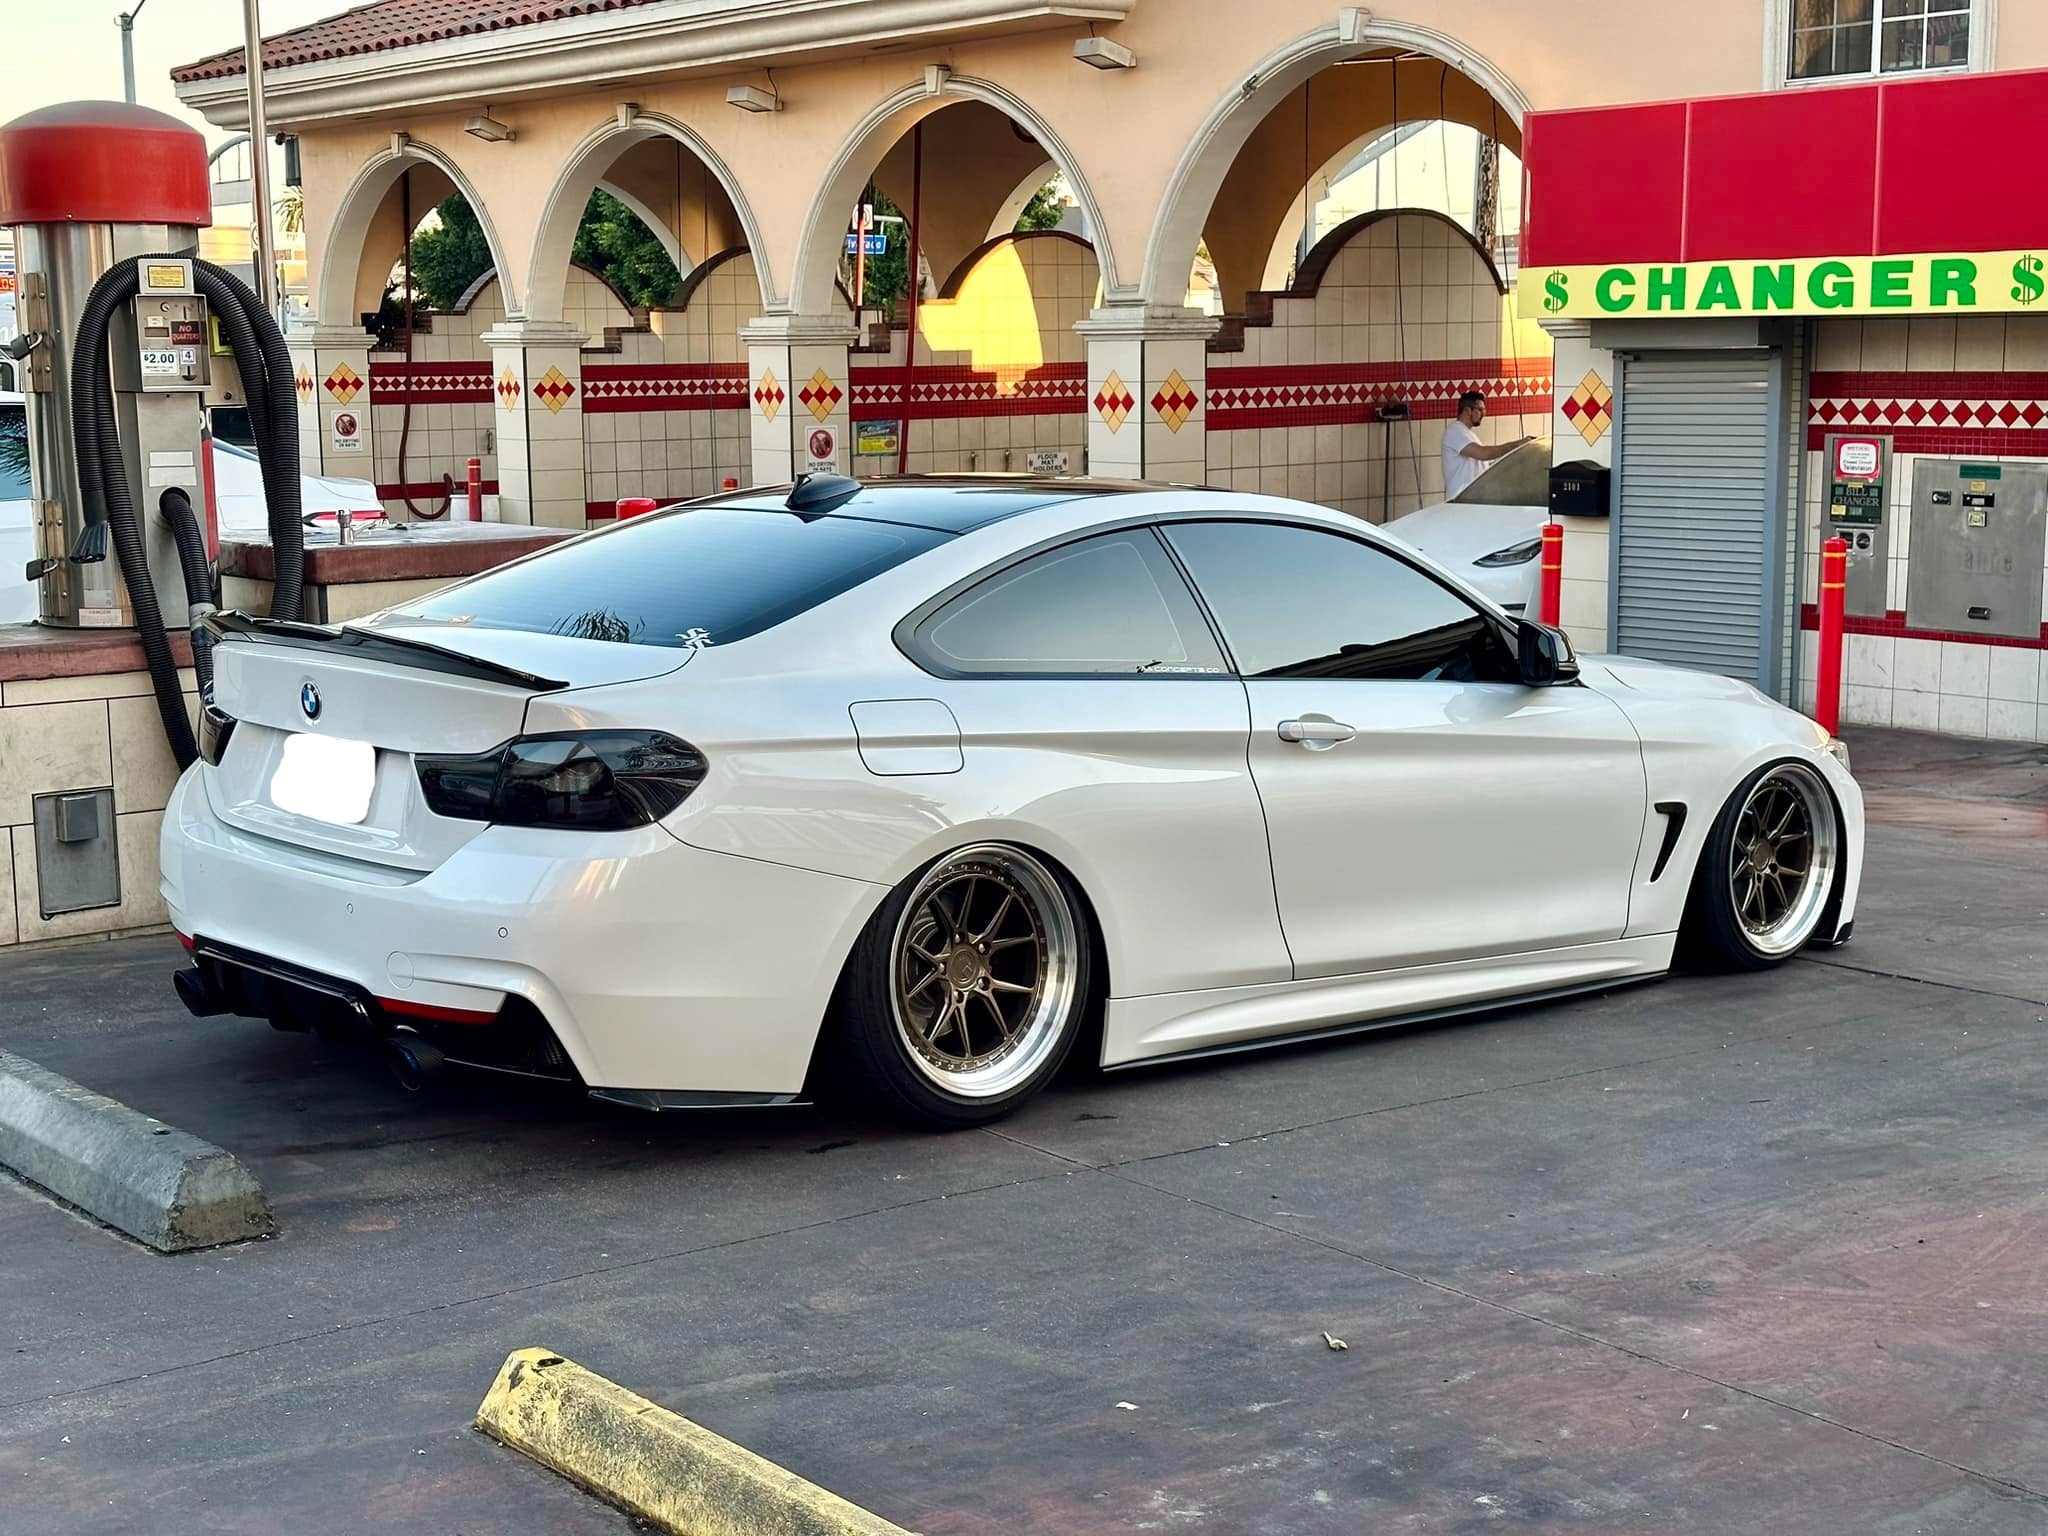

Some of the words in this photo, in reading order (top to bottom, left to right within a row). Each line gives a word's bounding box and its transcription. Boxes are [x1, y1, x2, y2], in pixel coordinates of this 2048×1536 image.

[1544, 269, 1569, 314] $
[1595, 258, 1978, 312] CHANGER
[2011, 253, 2045, 306] $
[144, 353, 175, 363] $2.00
[184, 351, 192, 359] 4
[1037, 453, 1058, 461] FLOOR
[1033, 464, 1063, 472] HOLDERS
[1846, 487, 1868, 497] BILL
[1833, 496, 1880, 507] CHANGER
